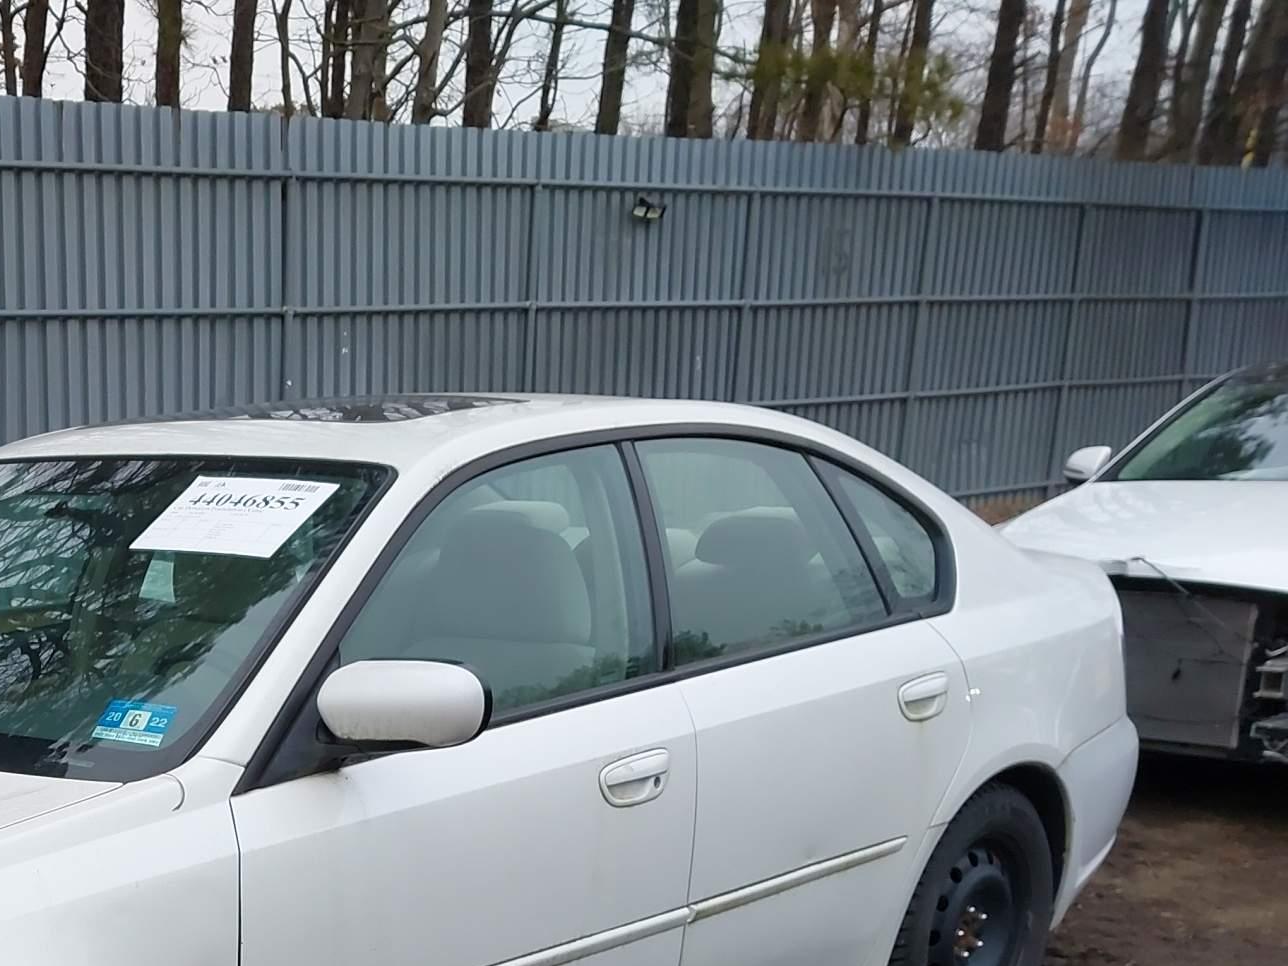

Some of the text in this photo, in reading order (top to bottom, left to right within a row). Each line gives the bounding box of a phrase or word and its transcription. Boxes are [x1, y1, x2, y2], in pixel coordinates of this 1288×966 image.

[189, 493, 306, 510] 44046855
[106, 711, 168, 727] 20 6 22
